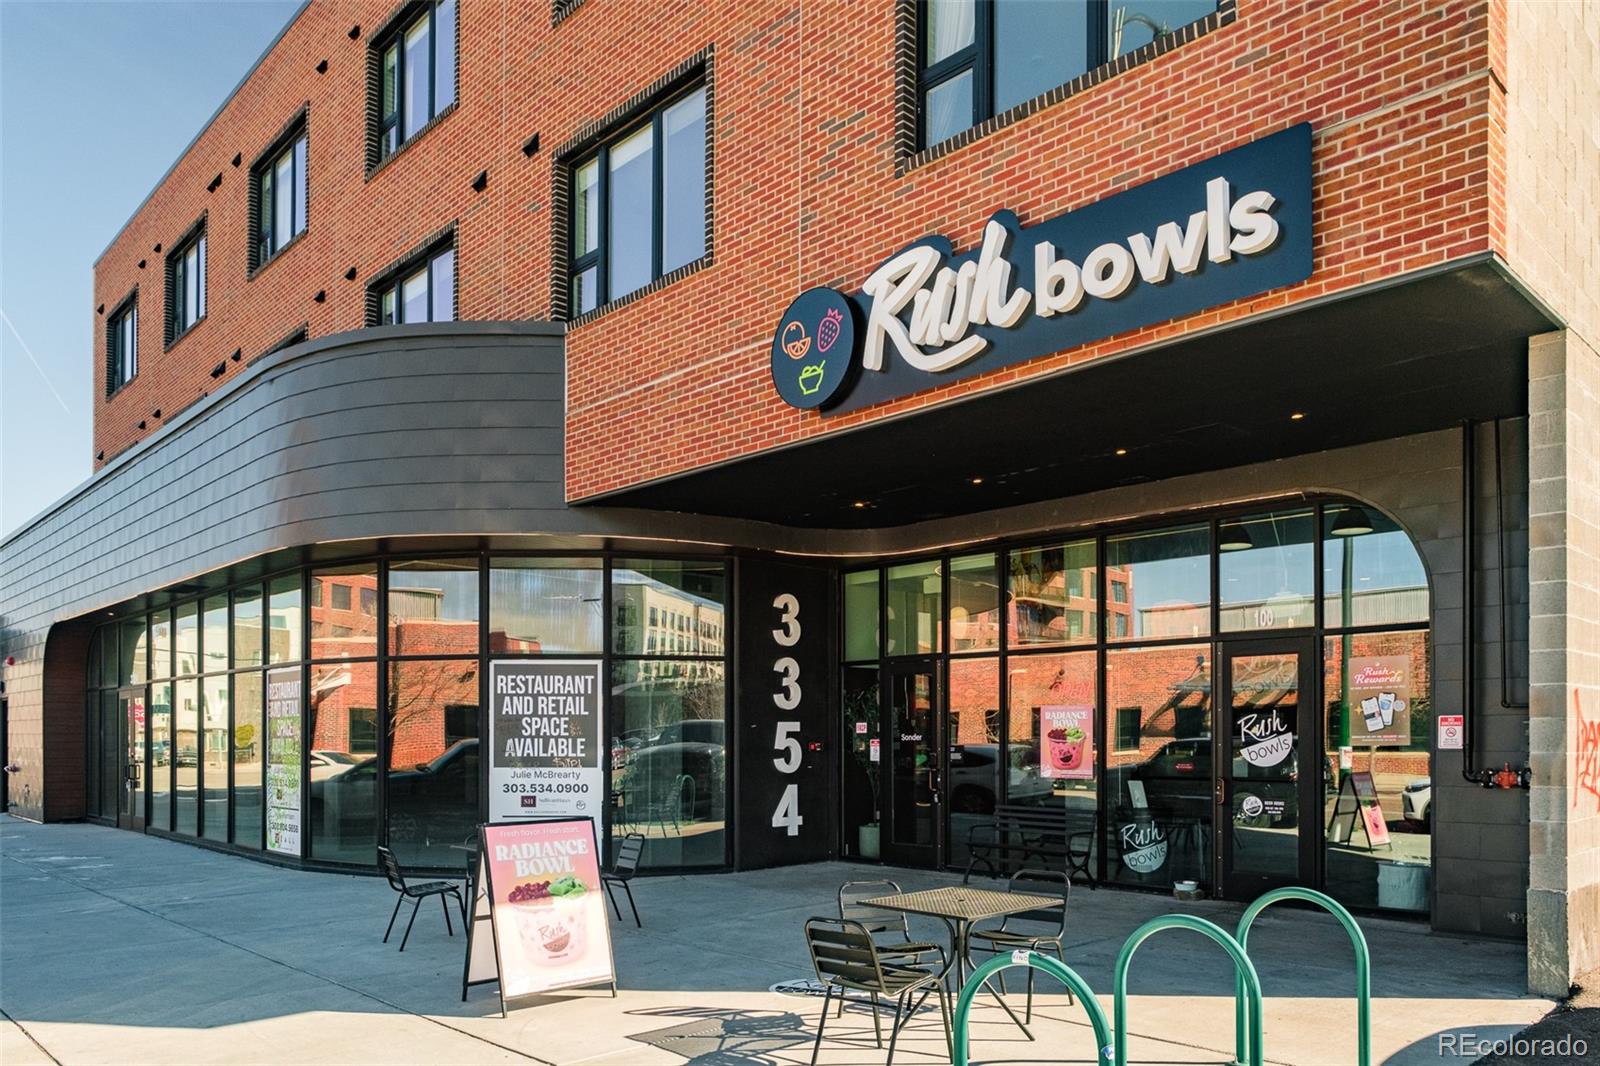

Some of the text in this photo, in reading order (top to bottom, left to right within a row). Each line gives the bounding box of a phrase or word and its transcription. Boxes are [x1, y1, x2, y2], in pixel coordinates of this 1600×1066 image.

[863, 176, 1279, 372] Rush bowls
[1354, 670, 1403, 684] Rewards
[1363, 667, 1391, 676] Rush
[497, 675, 595, 694] RESTAURANT
[502, 696, 589, 715] AND RETAIL
[1045, 711, 1088, 720] RADIANCE
[1052, 720, 1079, 728] BOWL
[521, 717, 569, 736] SPACE
[1237, 710, 1287, 742] Rush
[901, 733, 922, 741] Sonder
[505, 738, 586, 757] AVAILABLE
[1247, 738, 1290, 761] bowls
[510, 770, 581, 780] Julie McBrearty
[503, 784, 589, 793] 303.534.0900
[1120, 820, 1166, 850] Rush
[495, 838, 588, 861] RADIANCE
[1128, 847, 1166, 867] bowls
[516, 856, 576, 877] BOWL
